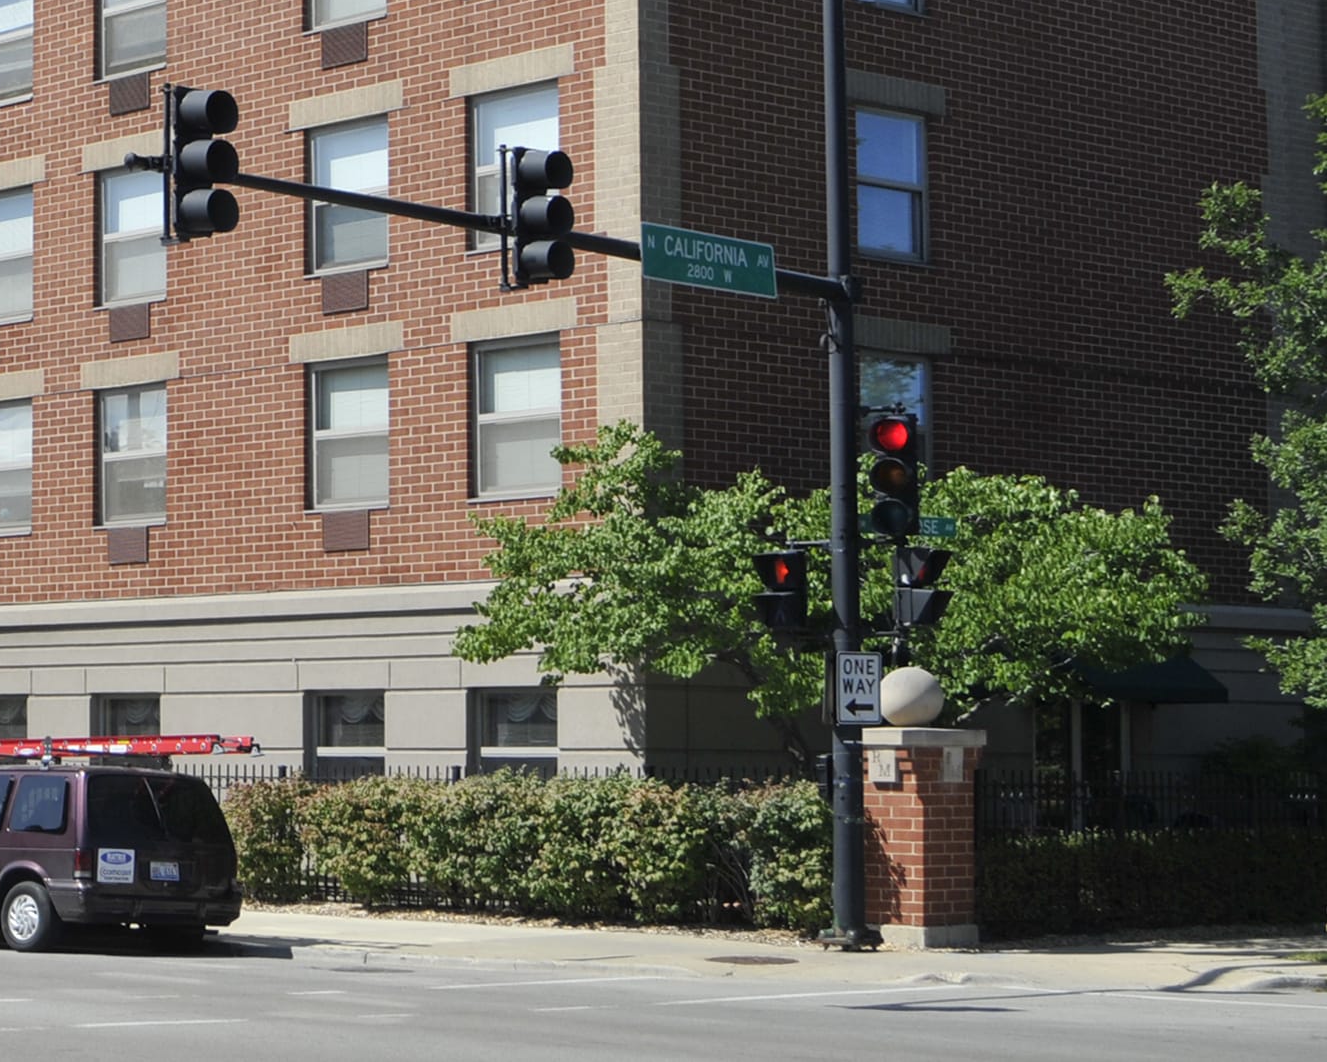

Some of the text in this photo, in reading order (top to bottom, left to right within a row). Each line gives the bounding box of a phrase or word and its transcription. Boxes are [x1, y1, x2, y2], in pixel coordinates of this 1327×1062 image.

[647, 235, 769, 268] N CALIFORNIA AV
[687, 263, 733, 282] 2800 W
[843, 658, 875, 675] ONE
[842, 678, 876, 695] WAY
[878, 763, 891, 777] M
